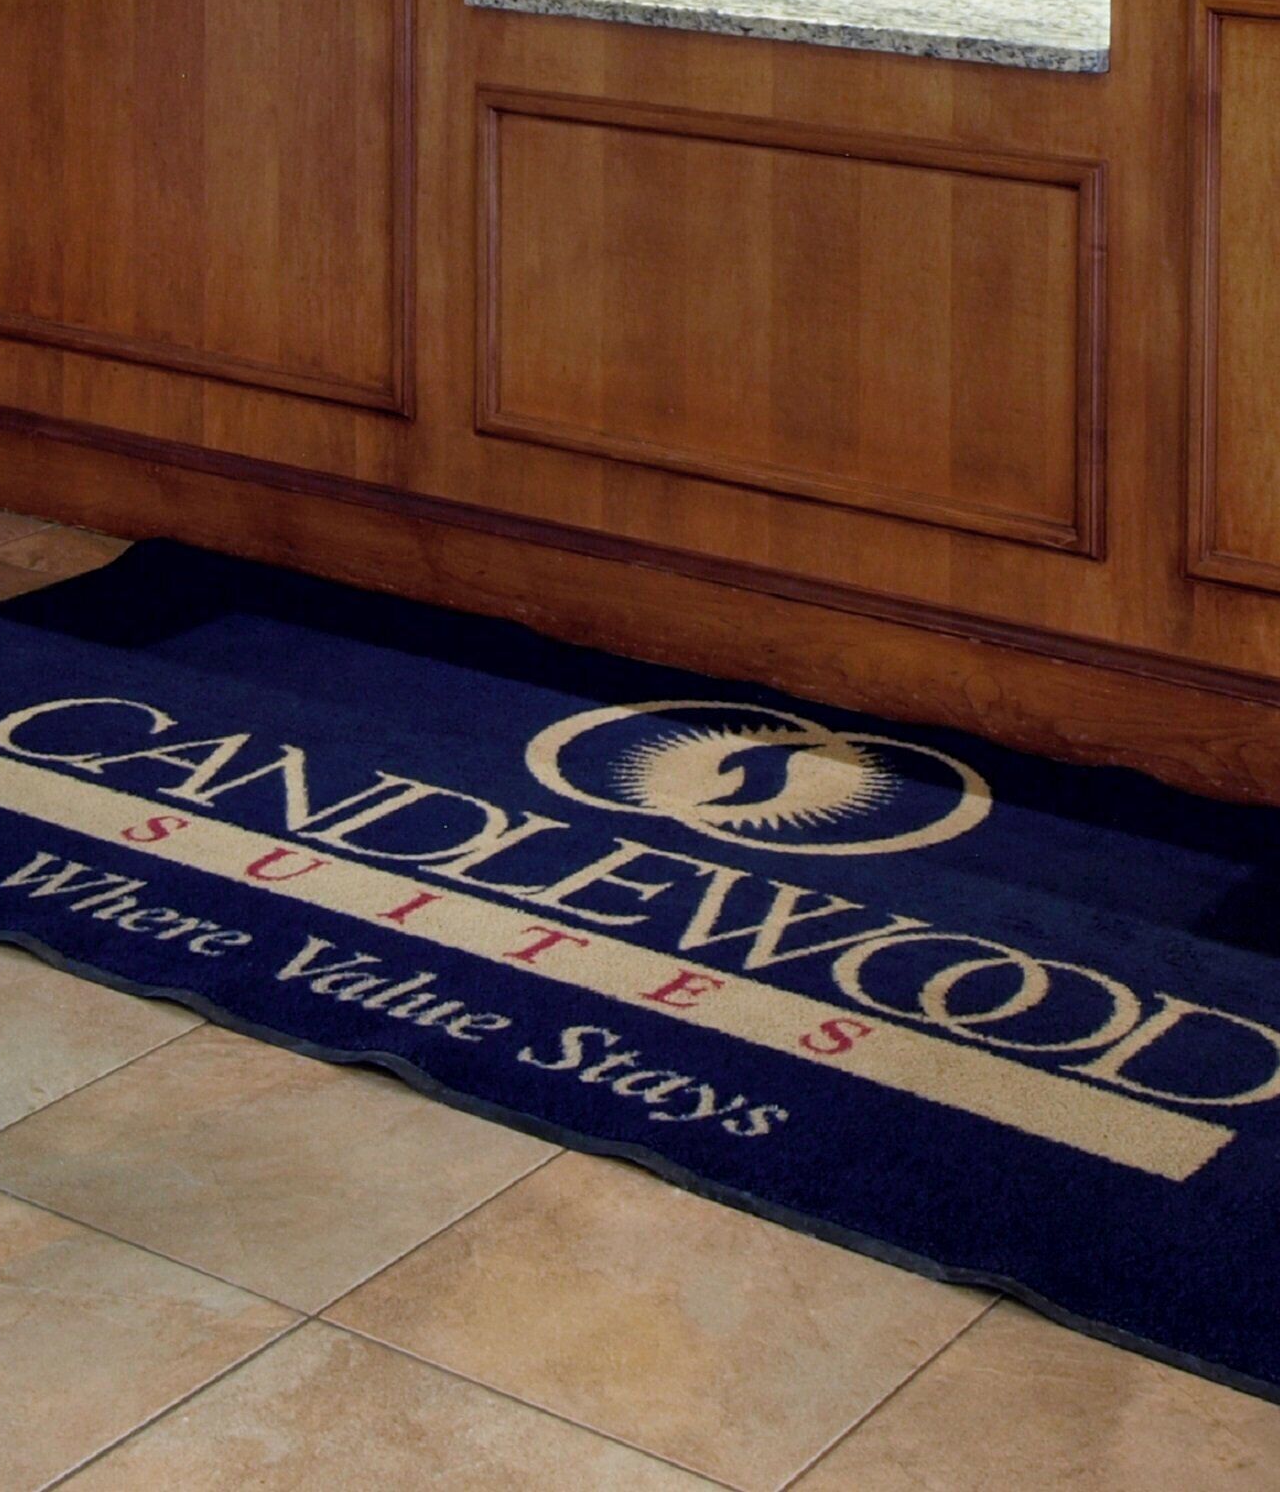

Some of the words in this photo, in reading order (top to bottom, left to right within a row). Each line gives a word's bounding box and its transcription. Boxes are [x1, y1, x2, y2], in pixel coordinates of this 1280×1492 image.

[122, 814, 872, 1056] SUITES
[276, 936, 513, 1040] Value
[517, 1023, 790, 1137] Stays
